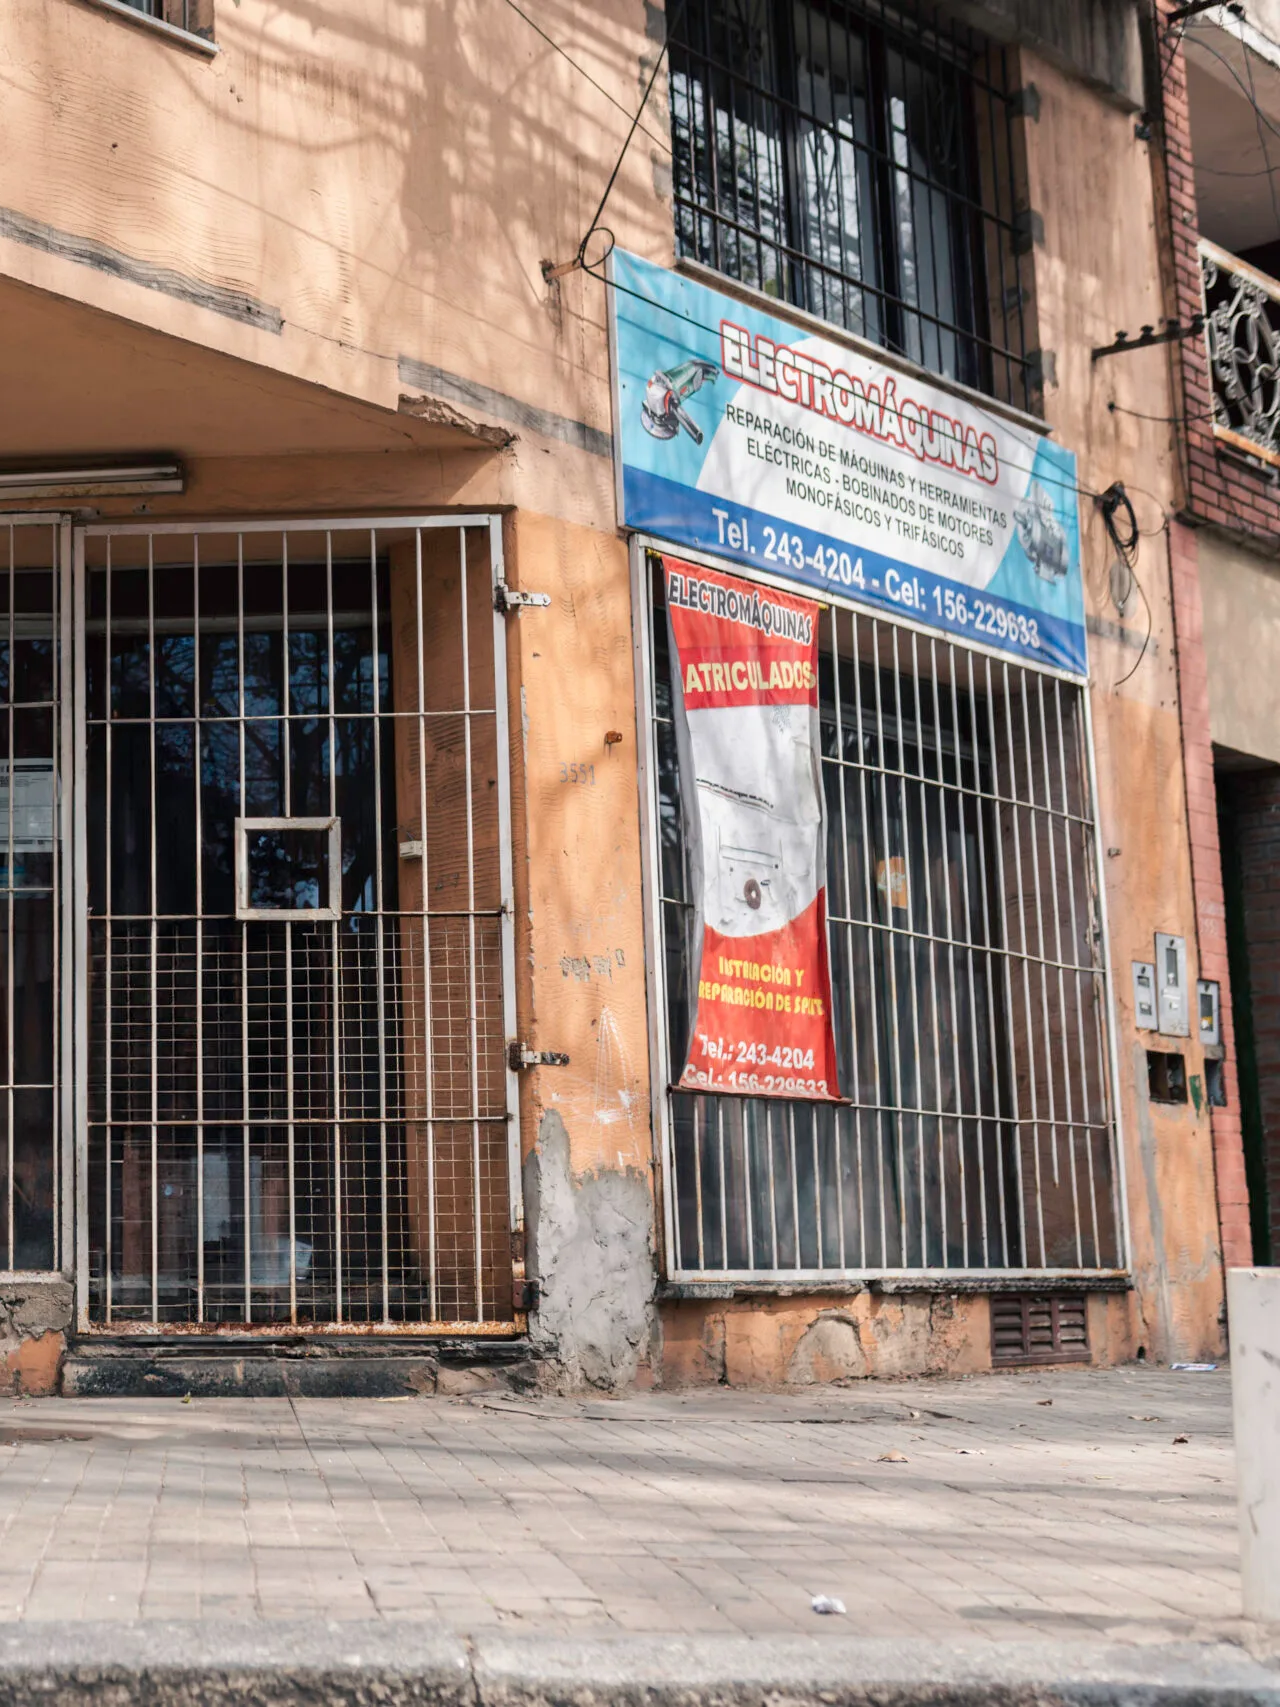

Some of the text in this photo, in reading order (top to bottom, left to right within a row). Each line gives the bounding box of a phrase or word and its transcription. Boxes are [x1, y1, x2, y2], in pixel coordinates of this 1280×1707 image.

[720, 319, 999, 485] ELECTROMÁQUINAS
[726, 404, 1007, 529] REPARACIÓN DE MÁQUINAS Y HERRAMIENTAS
[747, 438, 831, 484] ELÉCTRICAS
[843, 475, 915, 516] BOBINADOS
[920, 504, 935, 526] DE
[938, 512, 993, 546] MOTORES
[787, 477, 964, 559] MONOFÁSICOS Y TRIFÁSICOS
[669, 572, 812, 646] ELECTROMÁQUINAS
[712, 508, 755, 555] Tel.
[763, 527, 865, 591] 243-4204
[885, 568, 926, 612] Cel:
[933, 585, 1040, 650] 156-229633
[683, 660, 816, 694] ATRICULADOS
[559, 762, 596, 785] 3551
[776, 993, 791, 1013] DE
[795, 969, 804, 987] Y
[736, 1040, 815, 1070] 243-4204
